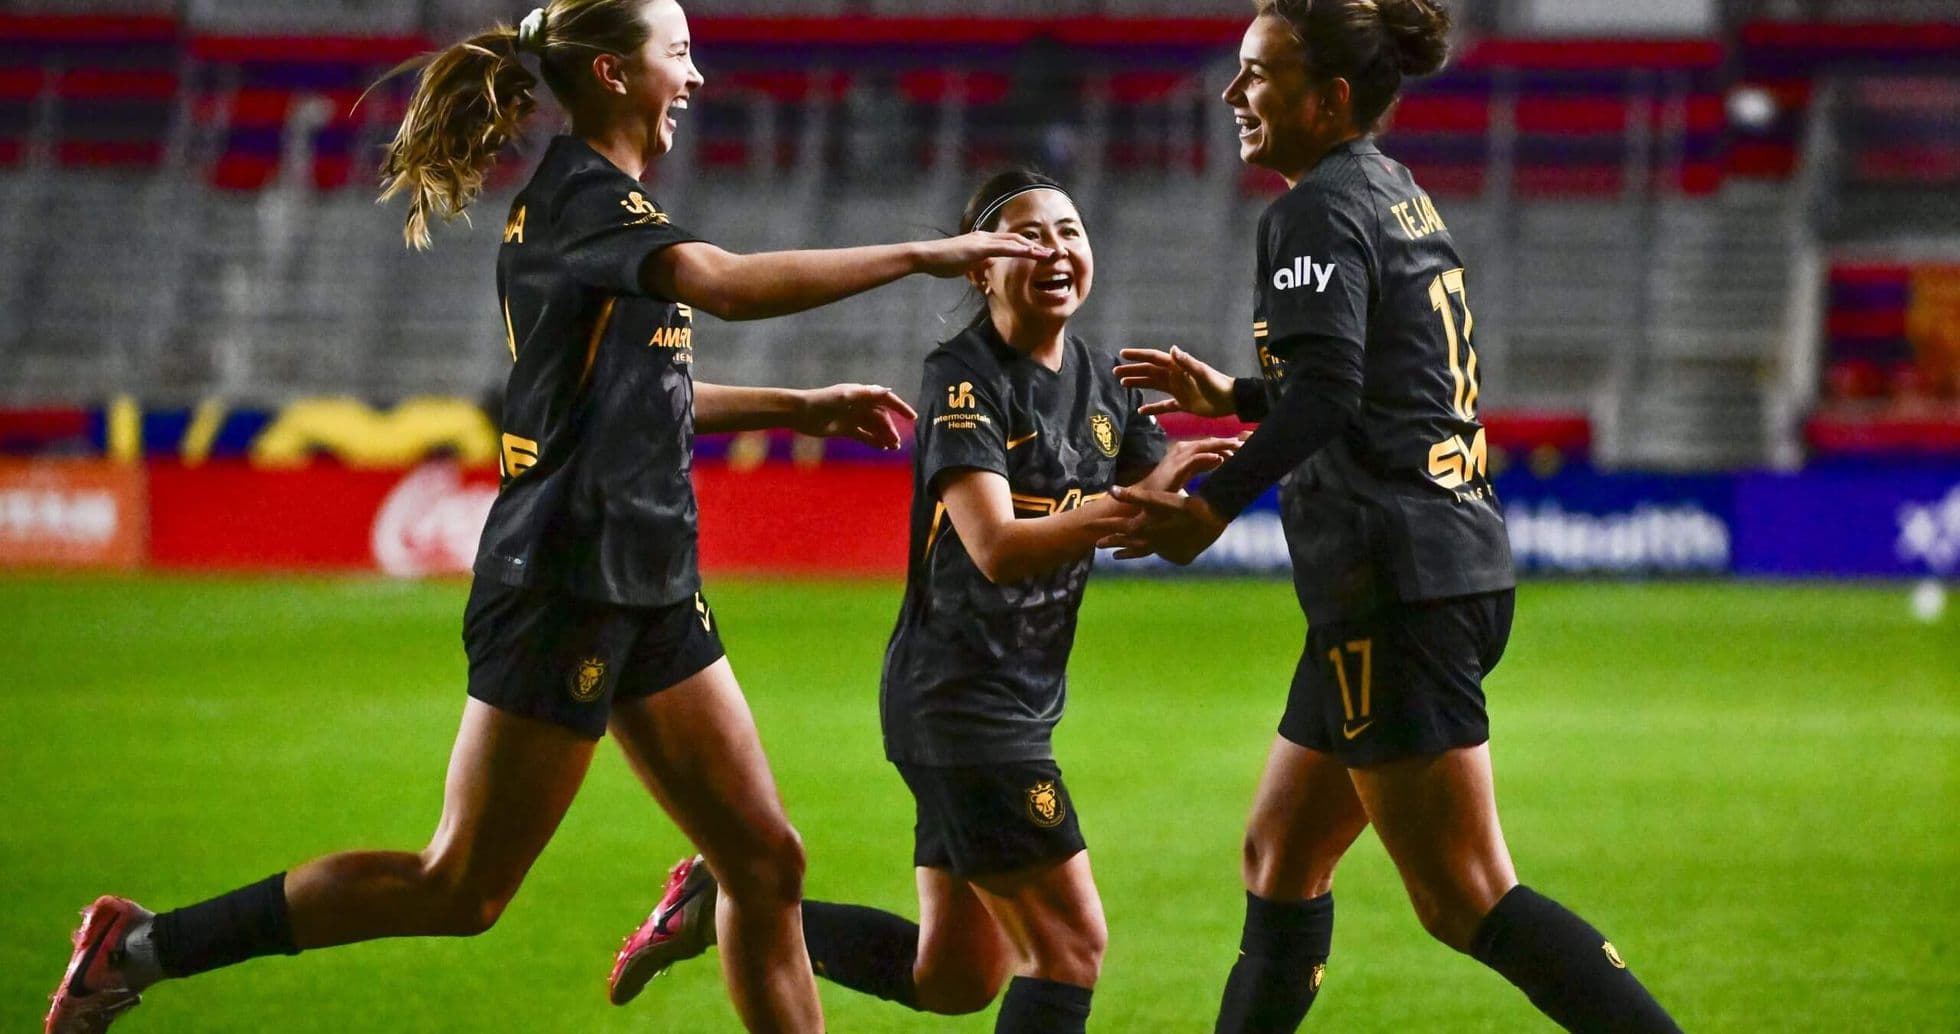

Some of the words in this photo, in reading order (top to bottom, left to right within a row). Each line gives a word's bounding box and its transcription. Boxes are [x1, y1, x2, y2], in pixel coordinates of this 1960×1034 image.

[1273, 255, 1335, 292] ally
[1428, 267, 1478, 420] 17
[948, 420, 977, 430] Health
[1329, 639, 1372, 720] 17
